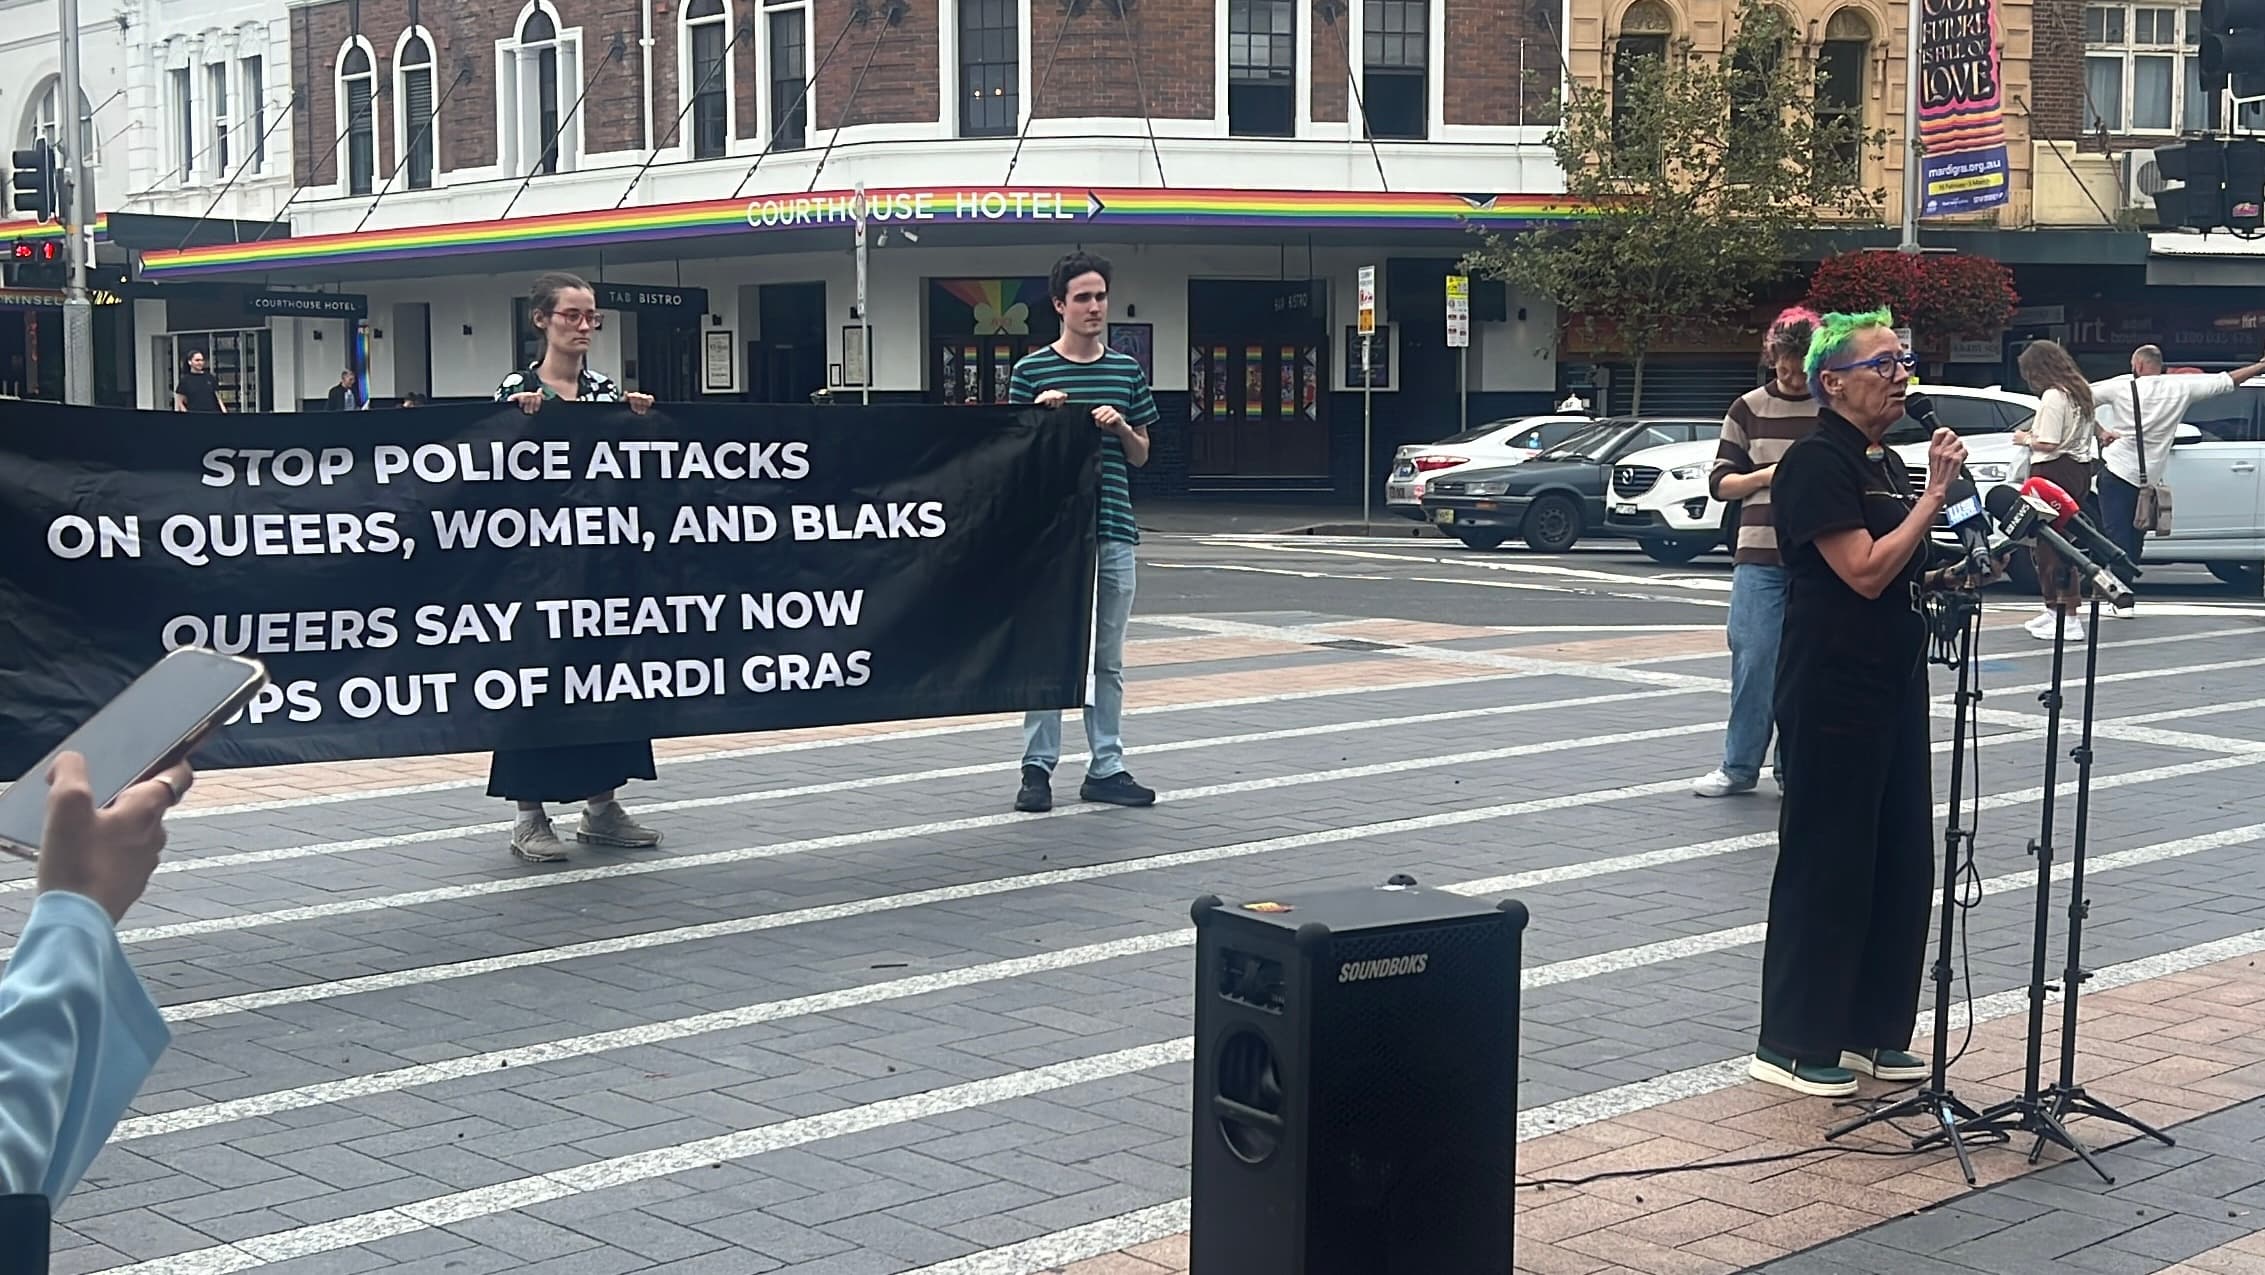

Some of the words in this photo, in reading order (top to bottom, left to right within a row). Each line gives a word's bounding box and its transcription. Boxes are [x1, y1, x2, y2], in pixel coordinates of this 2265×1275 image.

[1922, 12, 1987, 43] FUTURE
[1922, 47, 1934, 64] IS
[1935, 43, 1966, 62] FULL
[1967, 39, 1987, 56] OF
[1922, 60, 1991, 103] LOVE
[747, 192, 934, 227] COURTHOUSE
[956, 191, 1075, 220] HOTEL
[255, 298, 322, 310] COURTHOUSE
[324, 301, 356, 311] HOTEL
[609, 291, 632, 303] TAB
[639, 292, 682, 305] BISTRO
[202, 447, 354, 487] STOP
[374, 440, 572, 484] POLICE
[585, 441, 810, 480] ATTACKS
[2012, 503, 2031, 527] NEWS
[47, 514, 141, 559] ON
[160, 511, 416, 566] QUEERS,
[431, 506, 656, 552] WOMEN,
[669, 505, 777, 544] AND
[792, 501, 946, 541] BLAKS
[161, 607, 399, 654] QUEERS
[415, 601, 523, 646] SAY
[536, 594, 727, 639] TREATY
[741, 589, 864, 630] NOW
[224, 679, 322, 725] PS
[338, 672, 457, 719] OUT
[473, 667, 549, 710] OF
[565, 657, 726, 705] MARDI
[741, 650, 872, 693] GRAS
[1338, 954, 1429, 984] SOUNDBOKS
